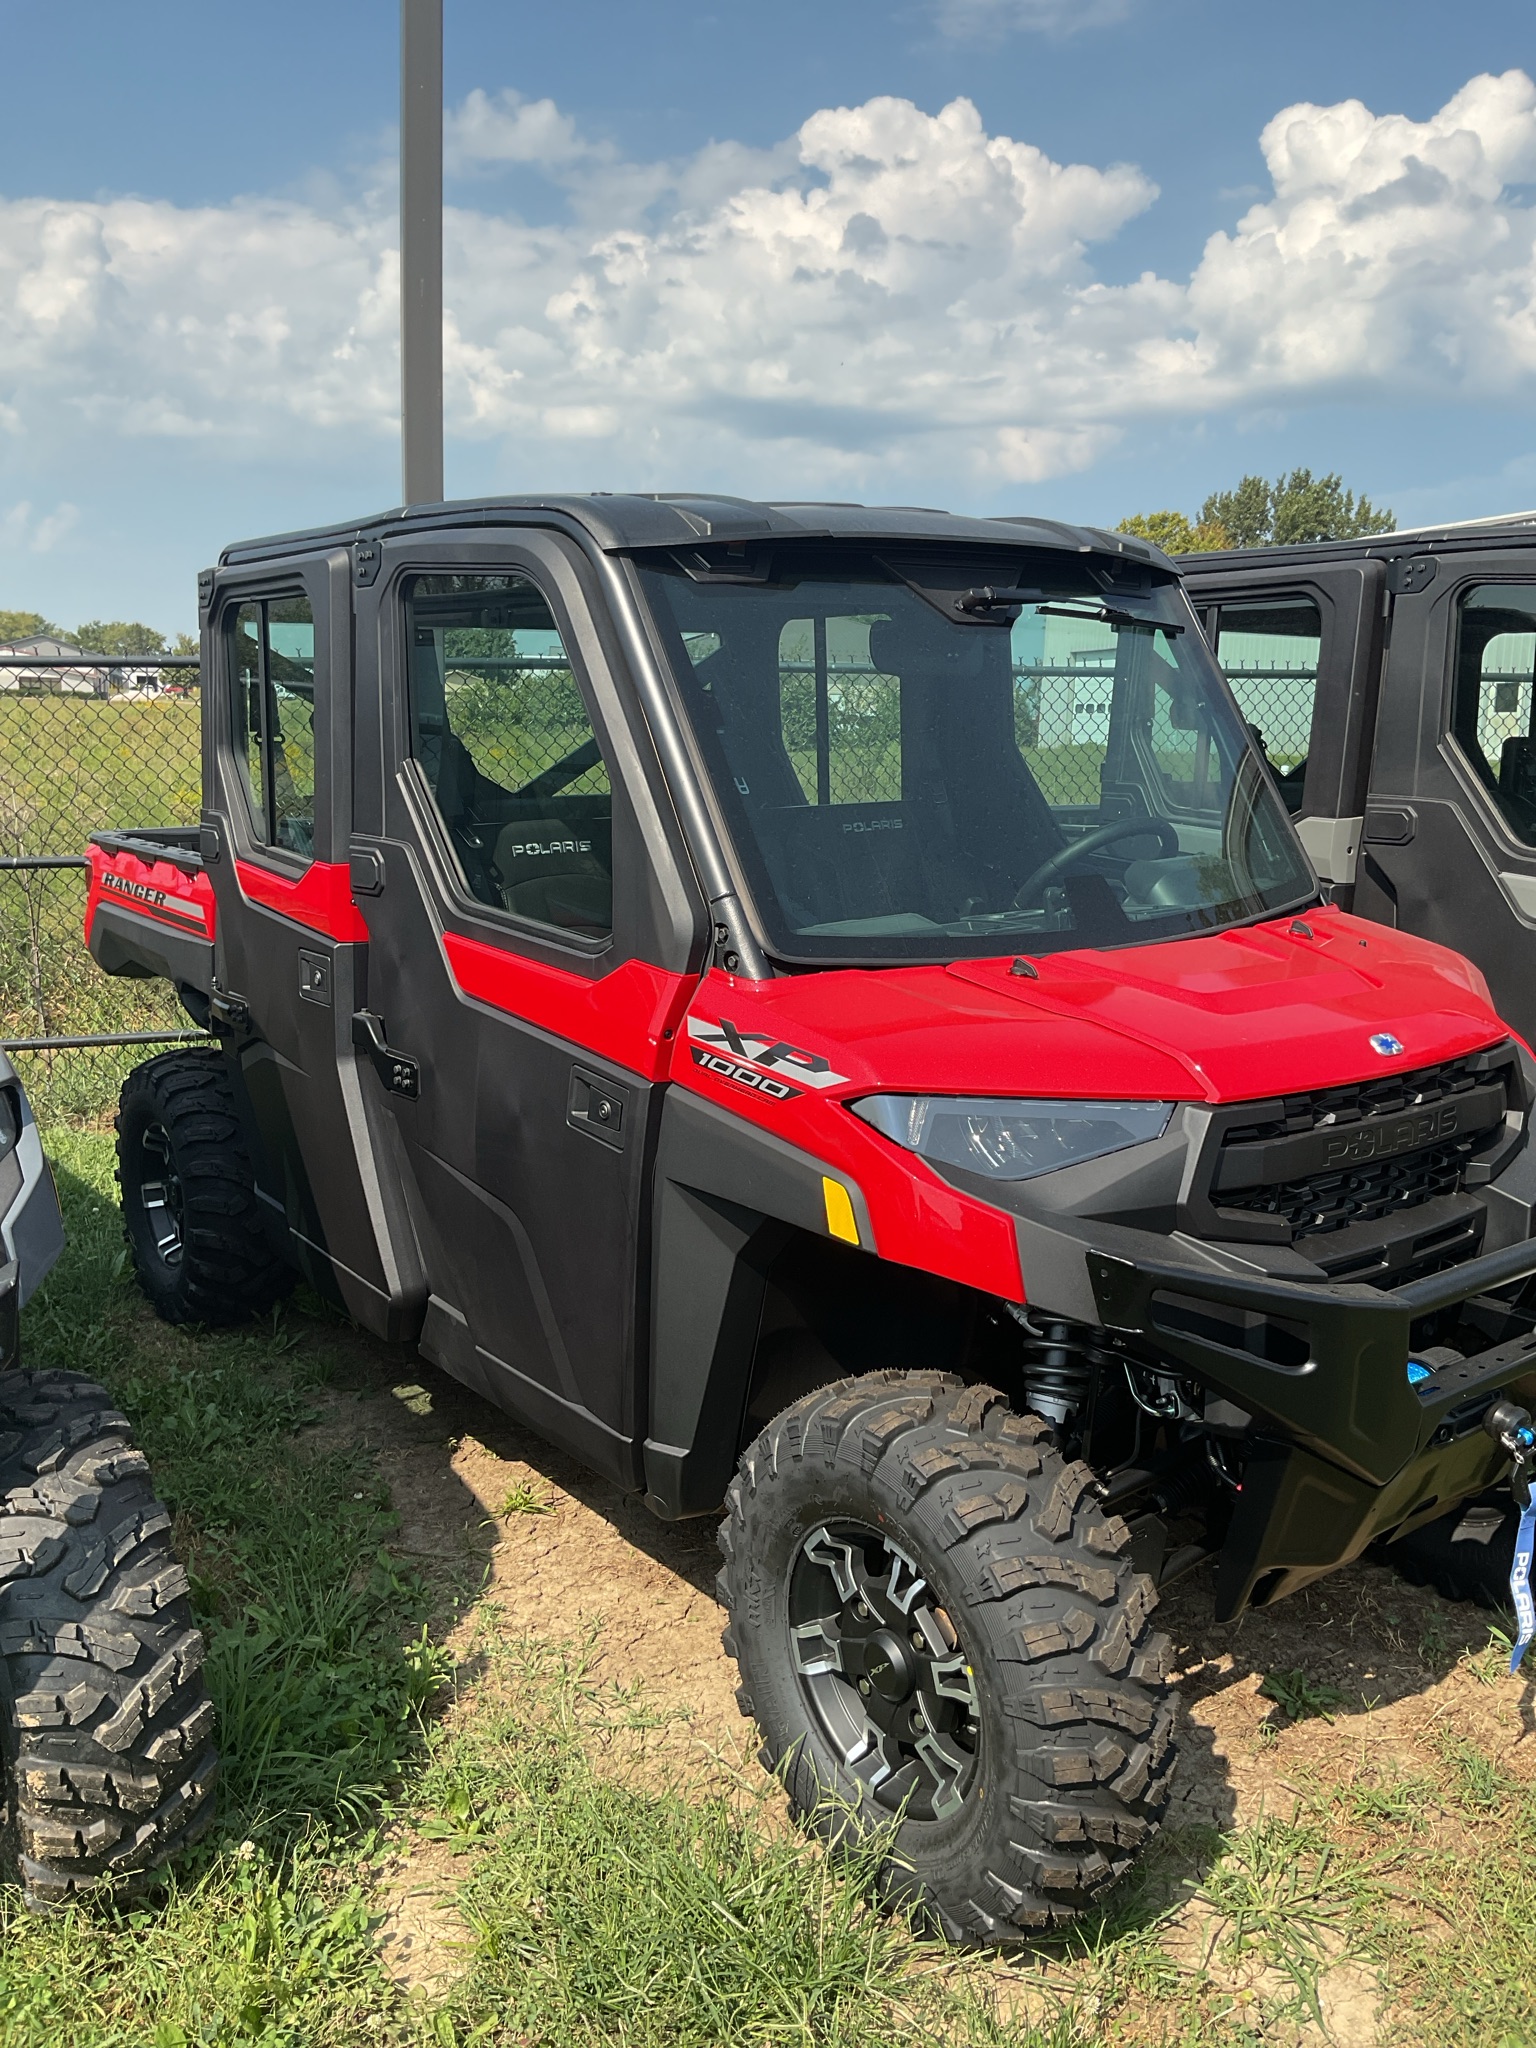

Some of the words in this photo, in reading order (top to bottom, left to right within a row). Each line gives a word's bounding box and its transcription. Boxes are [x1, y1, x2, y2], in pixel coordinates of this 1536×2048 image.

[842, 819, 904, 834] POLARIS
[511, 840, 592, 857] POLARIS
[102, 872, 167, 907] RANGER
[691, 1017, 831, 1074] XP
[699, 1052, 790, 1099] 1000
[1322, 1105, 1458, 1167] POLARIS
[1512, 1551, 1534, 1646] POLARIS
[869, 1662, 891, 1677] XP
